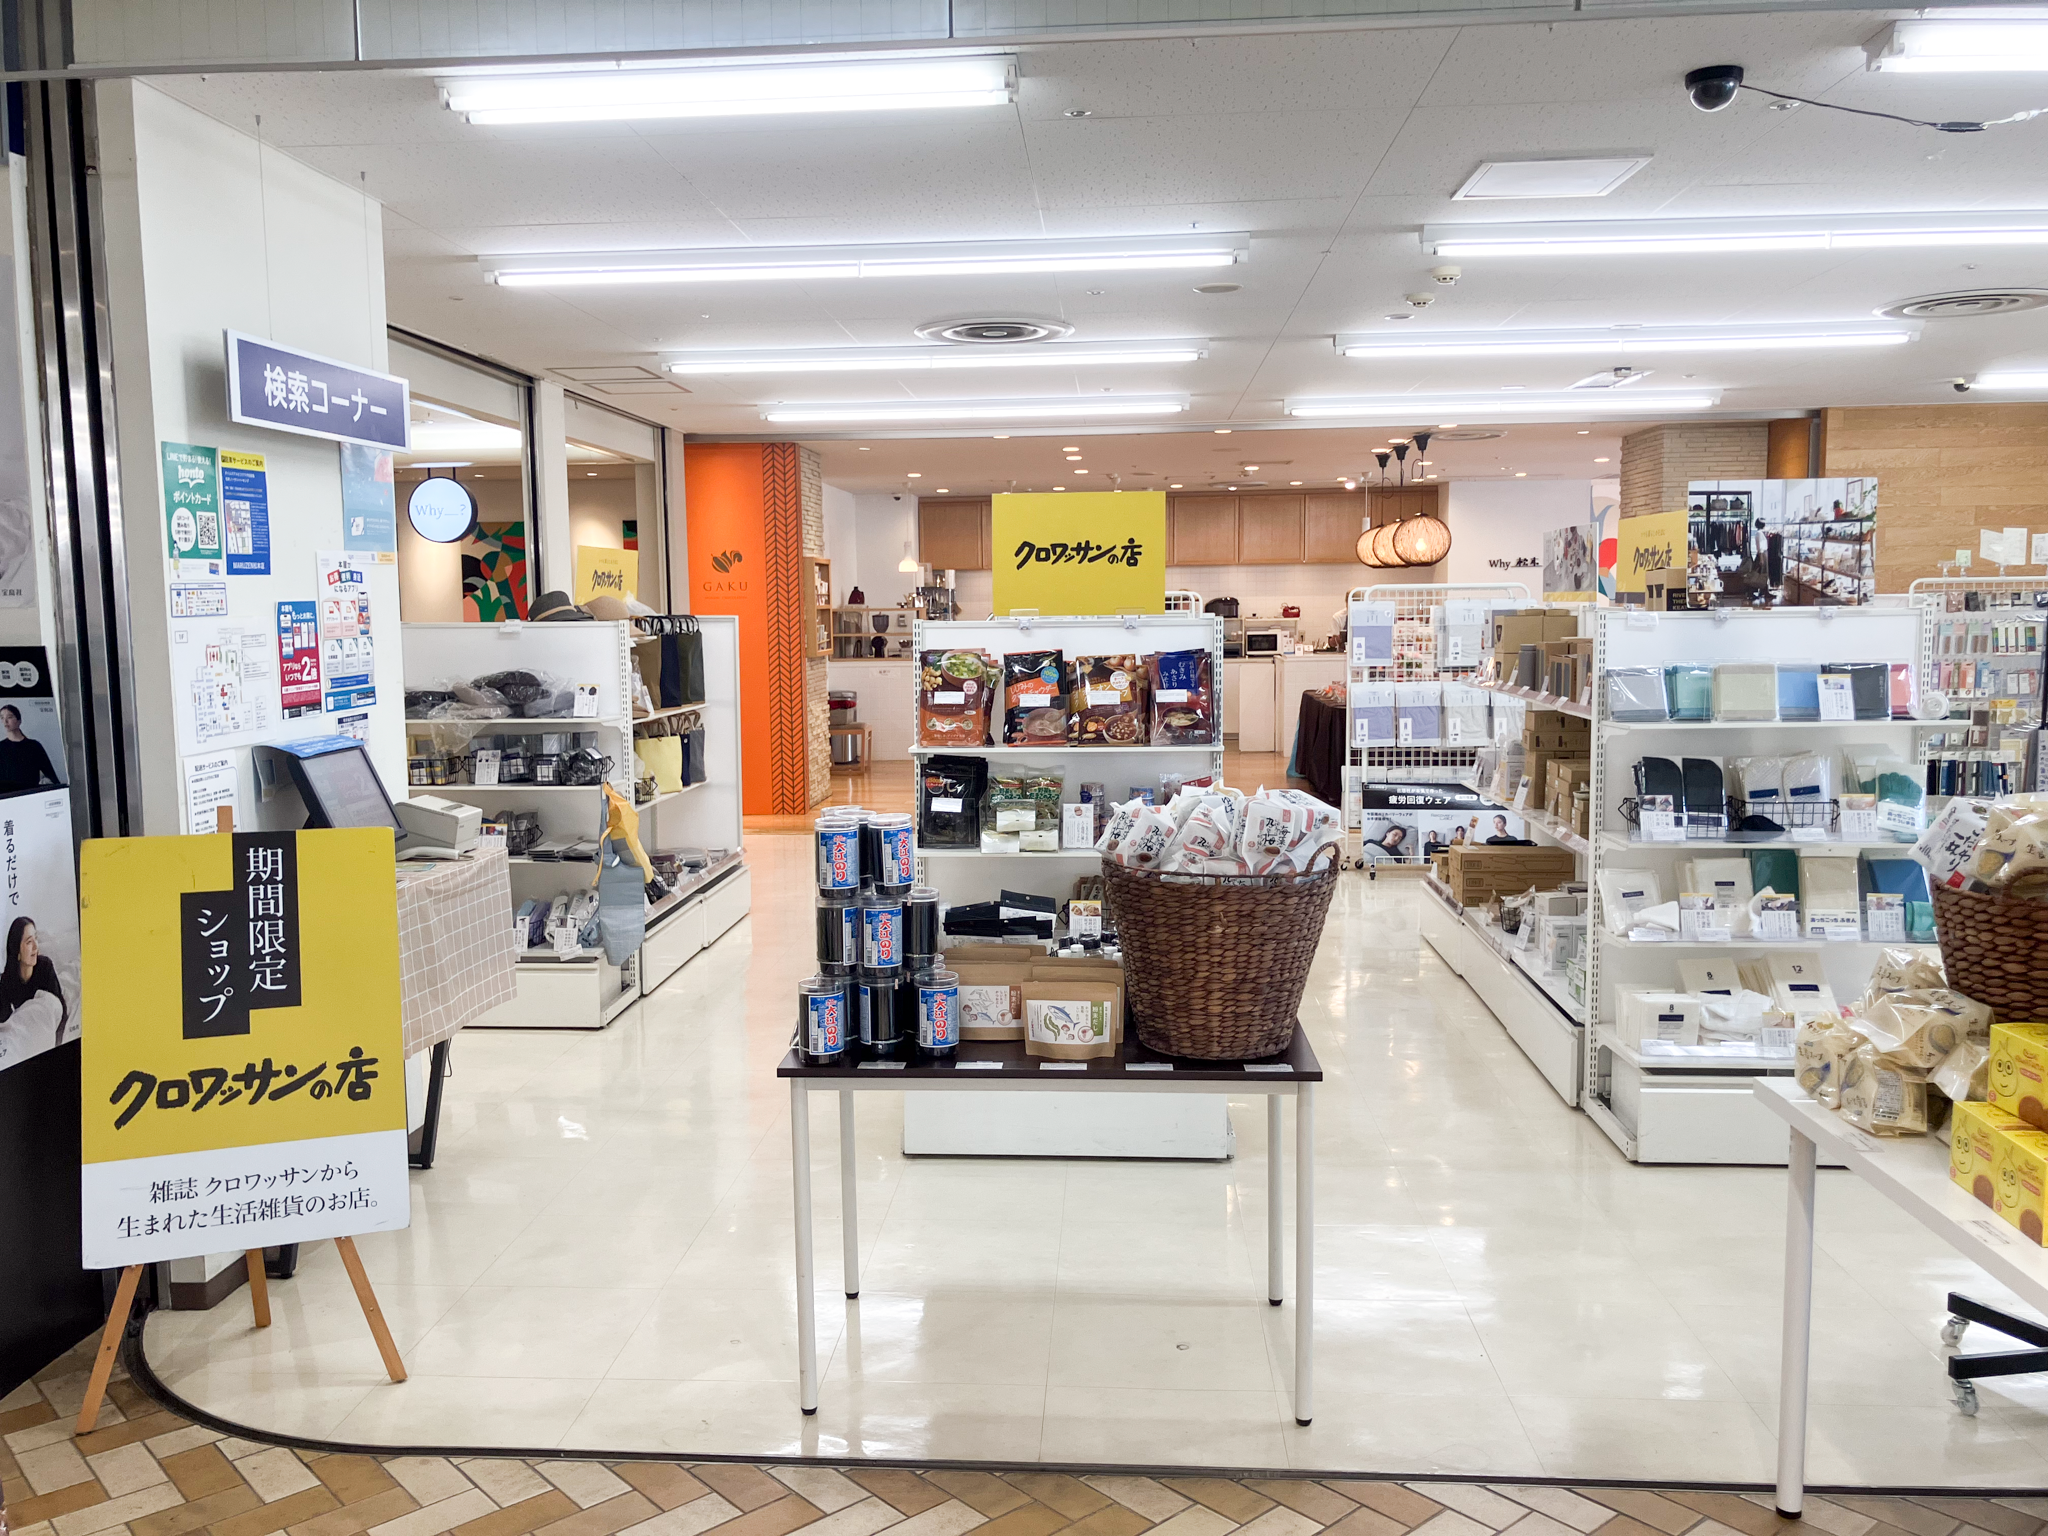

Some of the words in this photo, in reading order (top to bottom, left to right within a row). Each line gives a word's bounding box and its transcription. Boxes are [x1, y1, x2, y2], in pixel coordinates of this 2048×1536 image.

[264, 363, 387, 422] 検索コーナー
[178, 465, 204, 479] honto
[173, 491, 212, 505] ポイントカード
[1014, 537, 1143, 570] クロワッサンの店
[591, 569, 623, 592] クロワッサンの店
[702, 581, 748, 592] GAKU
[285, 674, 301, 682] いつでも
[1388, 795, 1451, 805] 疲労回復ウェア
[2, 819, 20, 906] 着るだけで
[834, 842, 847, 882] 大江のり
[899, 838, 910, 878] 大江のり
[246, 847, 288, 992] 期間限定
[879, 920, 893, 961] 大江のり
[198, 908, 234, 1023] ショップ
[1707, 971, 1713, 980] 8
[1792, 965, 1803, 973] 12
[826, 1006, 838, 1047] 大江のり
[934, 1001, 948, 1041] 大江のり
[1669, 1003, 1674, 1012] 8
[110, 1046, 378, 1130] クロワッサンの店
[149, 1178, 199, 1204] 雑誌
[205, 1160, 359, 1195] クロワッサンから
[117, 1187, 380, 1239] 生まれた生活雑貨のお店。
